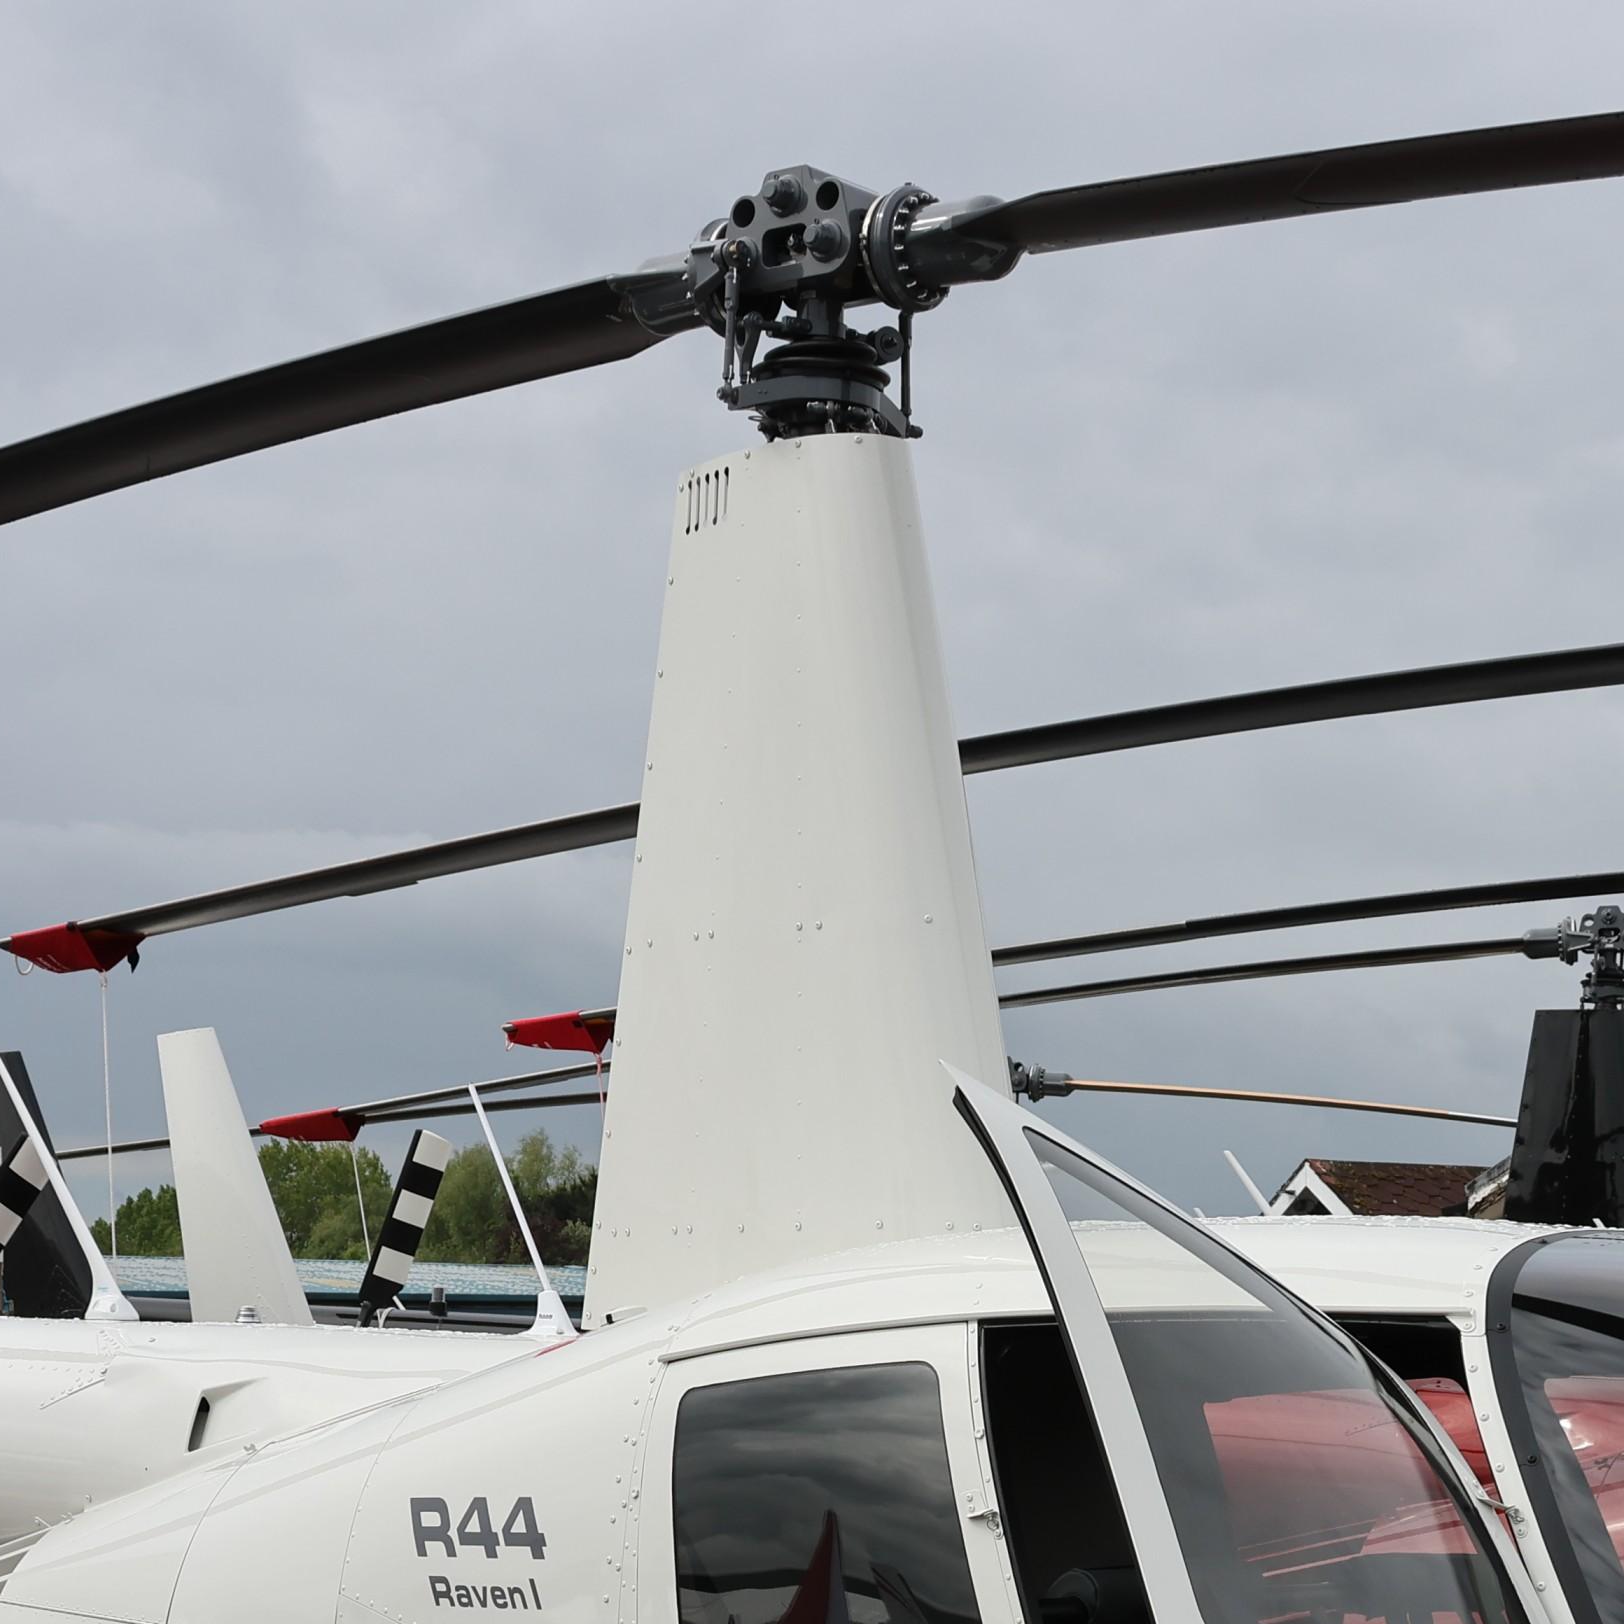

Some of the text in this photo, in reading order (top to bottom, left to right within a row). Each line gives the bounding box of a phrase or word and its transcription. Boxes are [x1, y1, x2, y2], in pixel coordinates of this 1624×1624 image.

[410, 1497, 547, 1560] R44
[429, 1575, 542, 1610] Raven I
